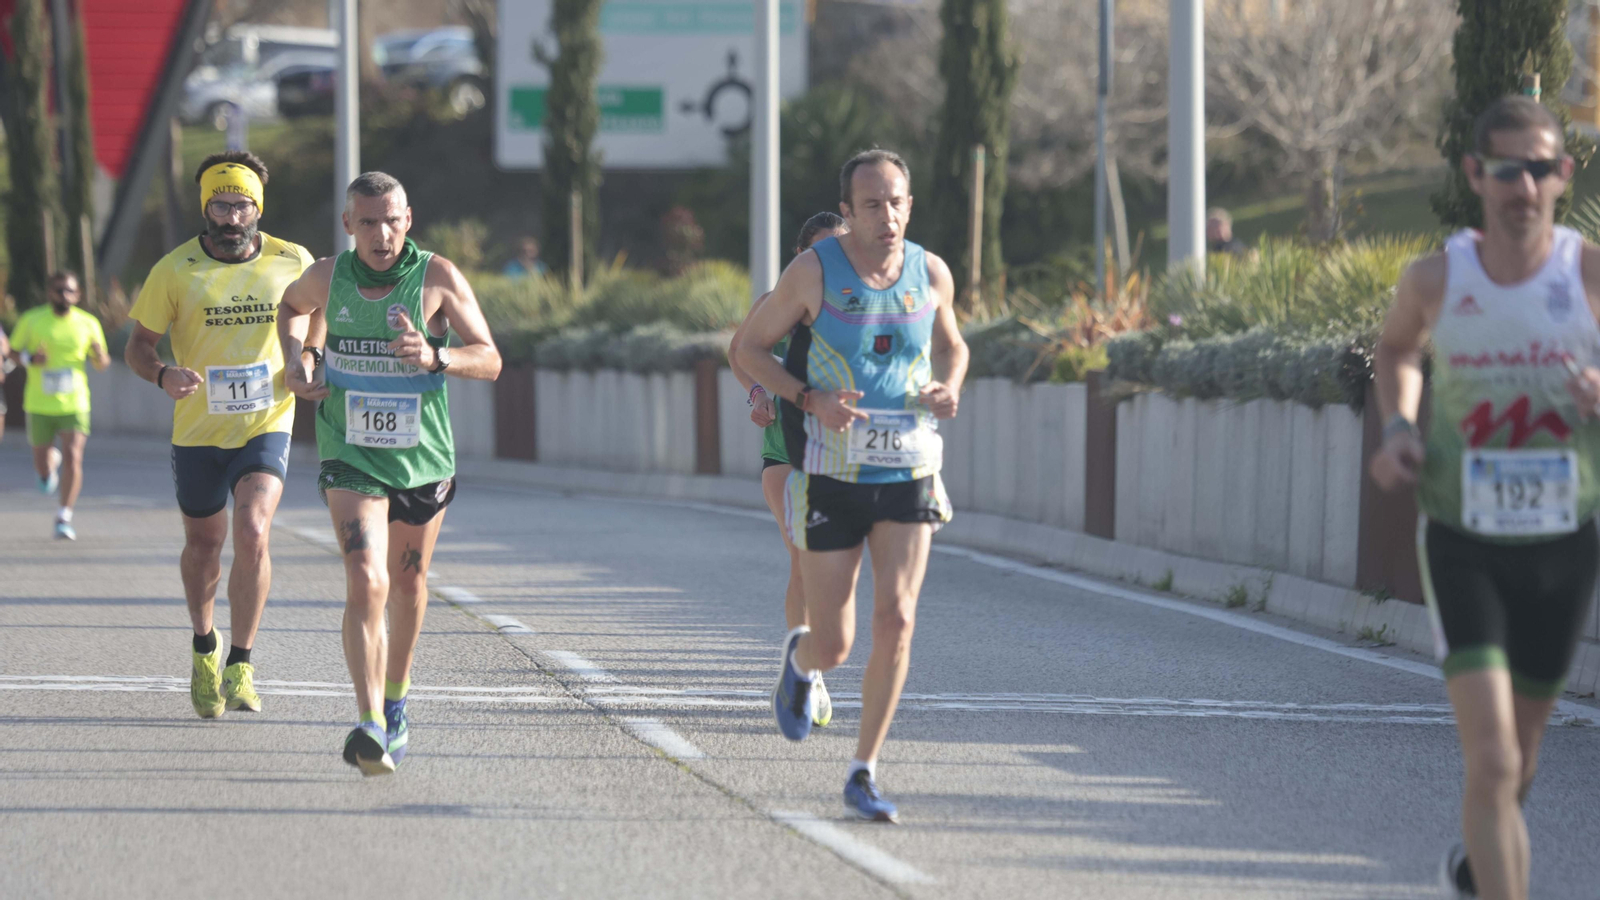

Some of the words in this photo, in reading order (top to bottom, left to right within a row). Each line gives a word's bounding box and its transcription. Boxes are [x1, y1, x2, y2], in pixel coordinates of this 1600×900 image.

[246, 294, 258, 302] A.
[204, 303, 279, 316] TESORILL
[339, 339, 400, 355] ATLETIS
[228, 381, 247, 400] 11
[362, 410, 397, 432] 168
[865, 429, 902, 451] 216
[1494, 474, 1544, 511] 192
